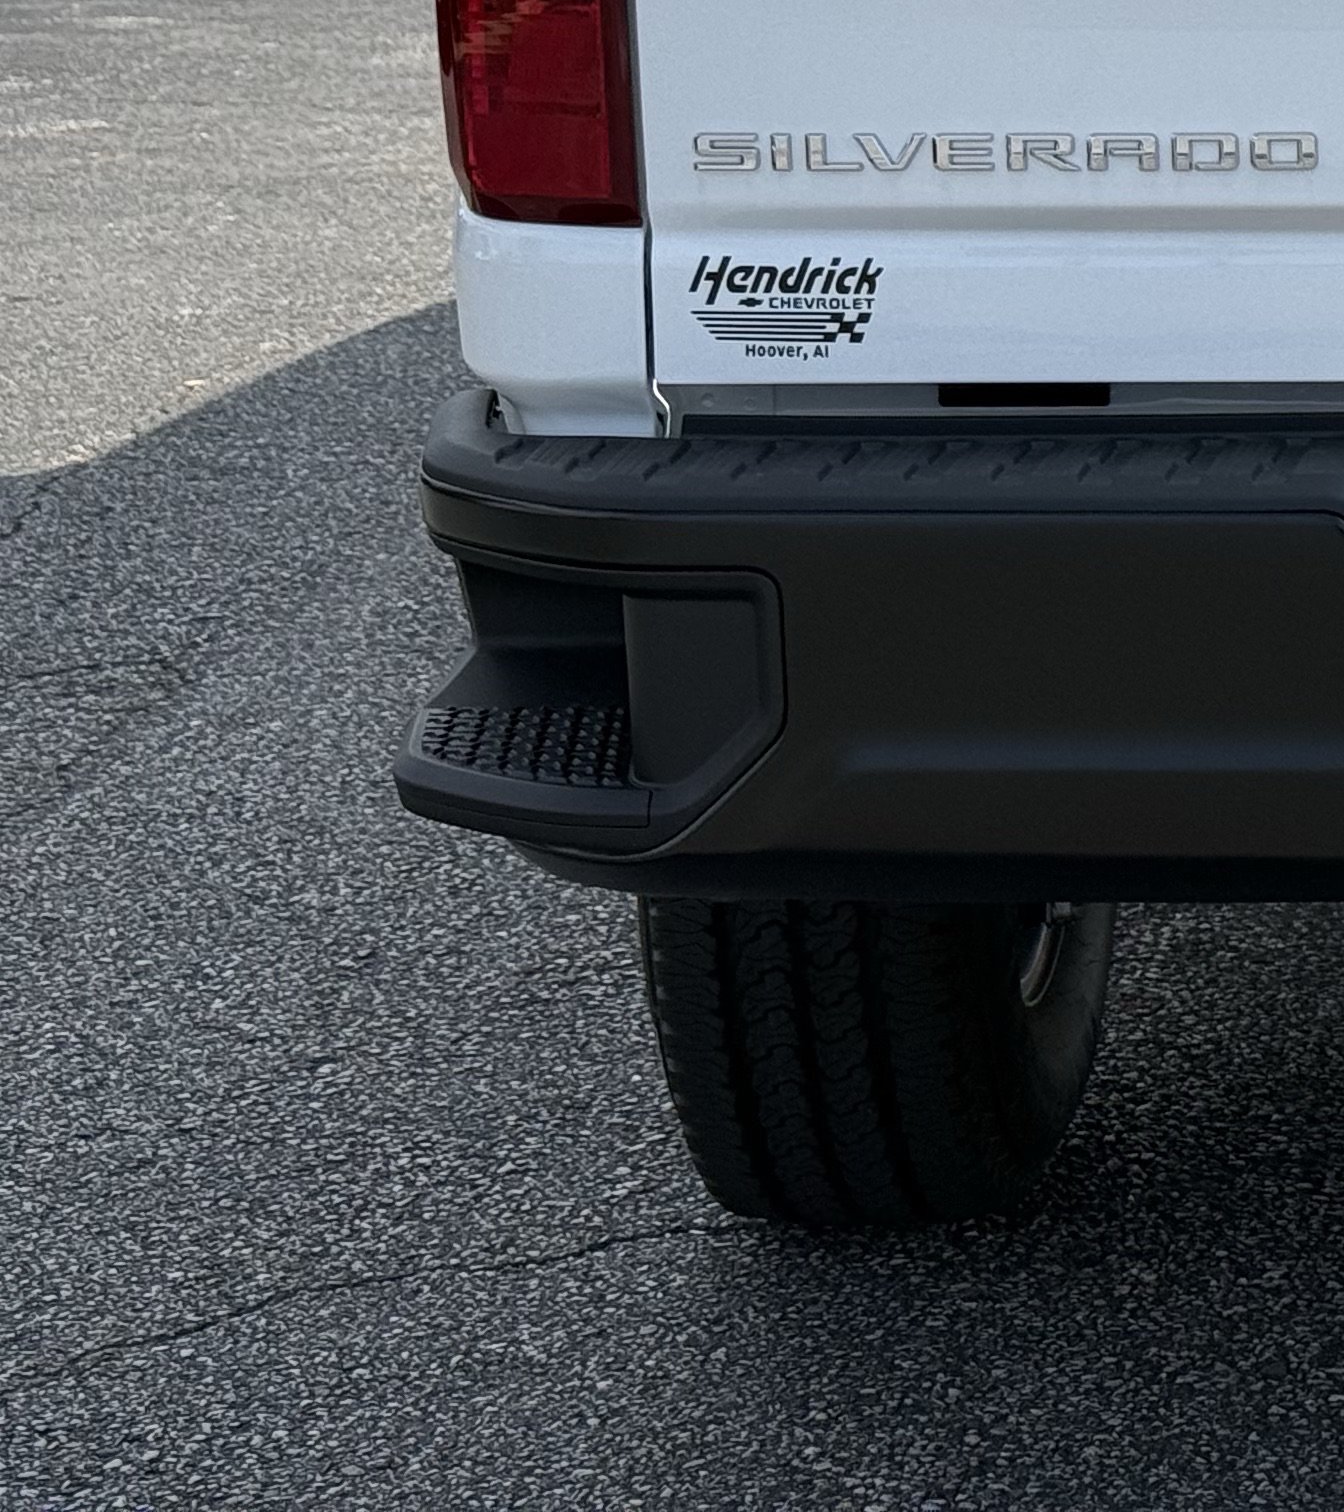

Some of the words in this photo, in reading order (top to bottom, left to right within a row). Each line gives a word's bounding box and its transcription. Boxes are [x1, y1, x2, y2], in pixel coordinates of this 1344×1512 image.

[692, 130, 1319, 174] SILVERADO
[688, 255, 885, 306] Hendrick
[768, 296, 876, 310] CHEVROLET
[744, 343, 809, 360] Hoover,
